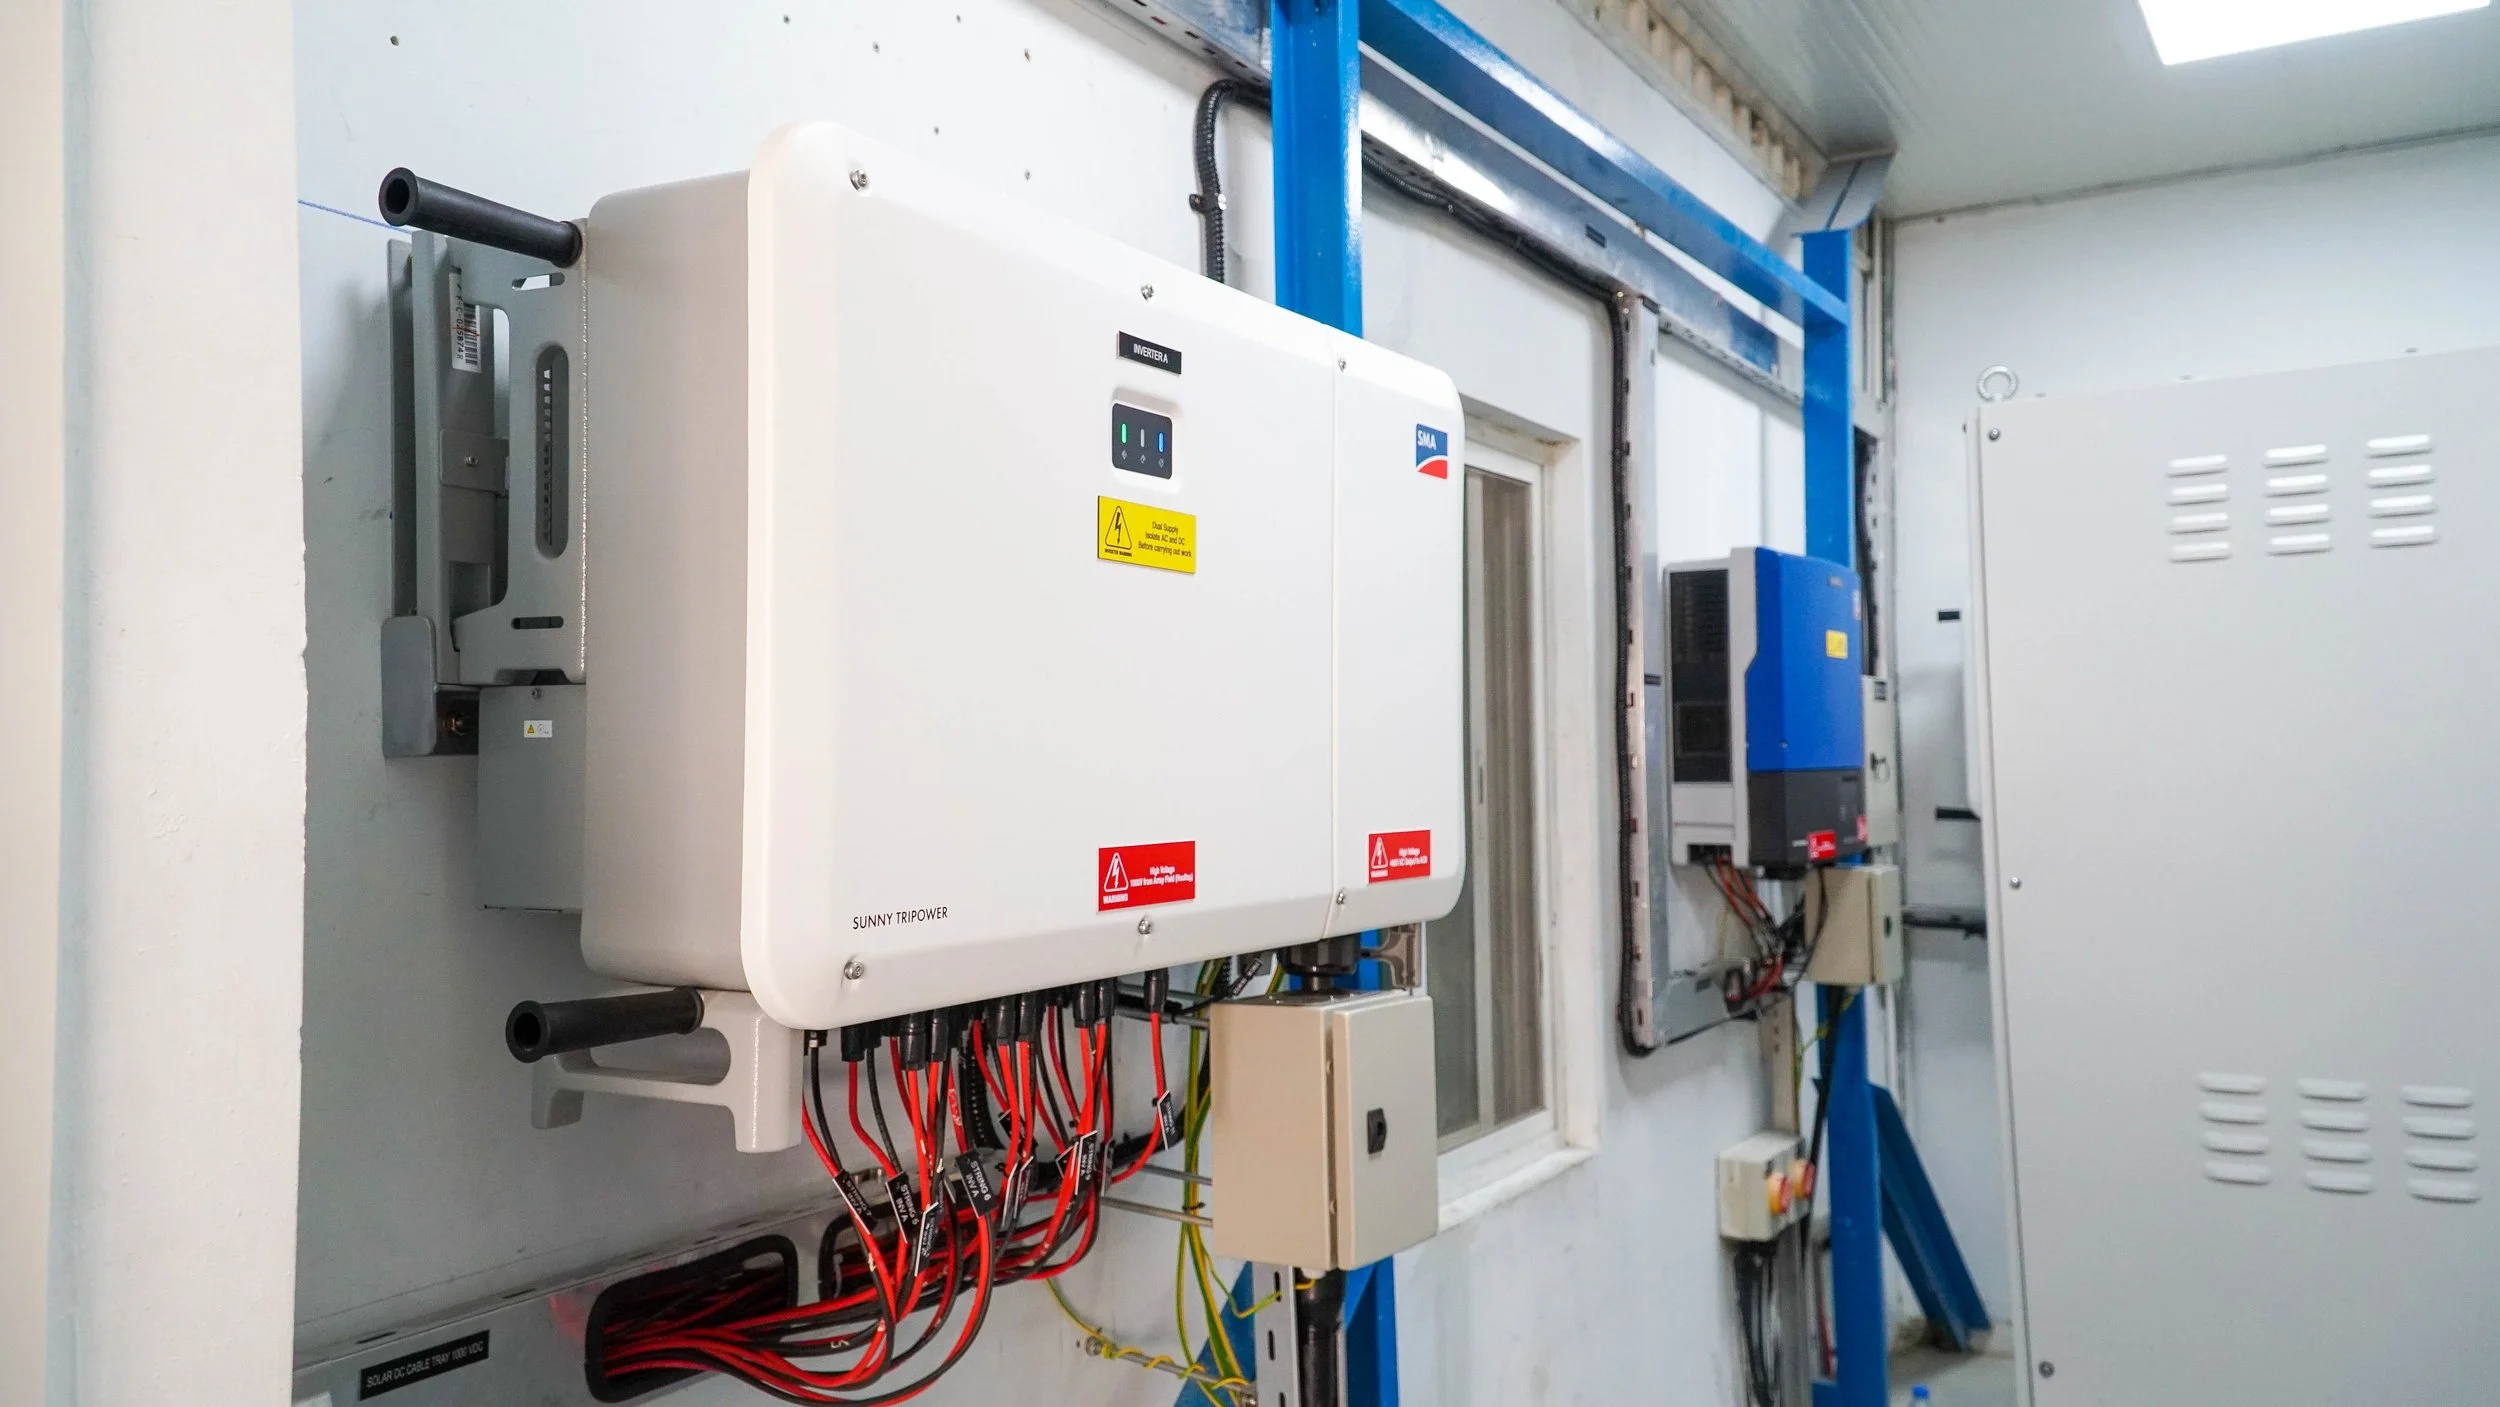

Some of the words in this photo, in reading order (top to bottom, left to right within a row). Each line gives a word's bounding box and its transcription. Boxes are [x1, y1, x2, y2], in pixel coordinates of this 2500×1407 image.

[1134, 344, 1163, 362] INVERTER
[1163, 354, 1168, 363] A
[1418, 430, 1437, 451] SMA
[1152, 521, 1162, 529] Dual
[1164, 523, 1178, 535] Supply
[1162, 534, 1168, 543] AC
[1178, 537, 1185, 545] DC
[1138, 541, 1153, 550] Before
[1154, 544, 1172, 556] carrying
[853, 913, 893, 929] SUNNY
[896, 907, 948, 924] TRIPOWER
[965, 1173, 977, 1188] INV
[971, 1190, 979, 1198] A
[970, 1160, 989, 1193] STRING
[847, 1181, 868, 1210] STRING
[901, 1184, 917, 1218] STRING
[896, 1198, 906, 1214] INV
[901, 1214, 909, 1223] A
[367, 1370, 392, 1388] SOLAR
[394, 1366, 405, 1380] DC
[406, 1358, 430, 1375] CABLE
[431, 1353, 450, 1367] TRAY
[468, 1341, 484, 1354] VDC
